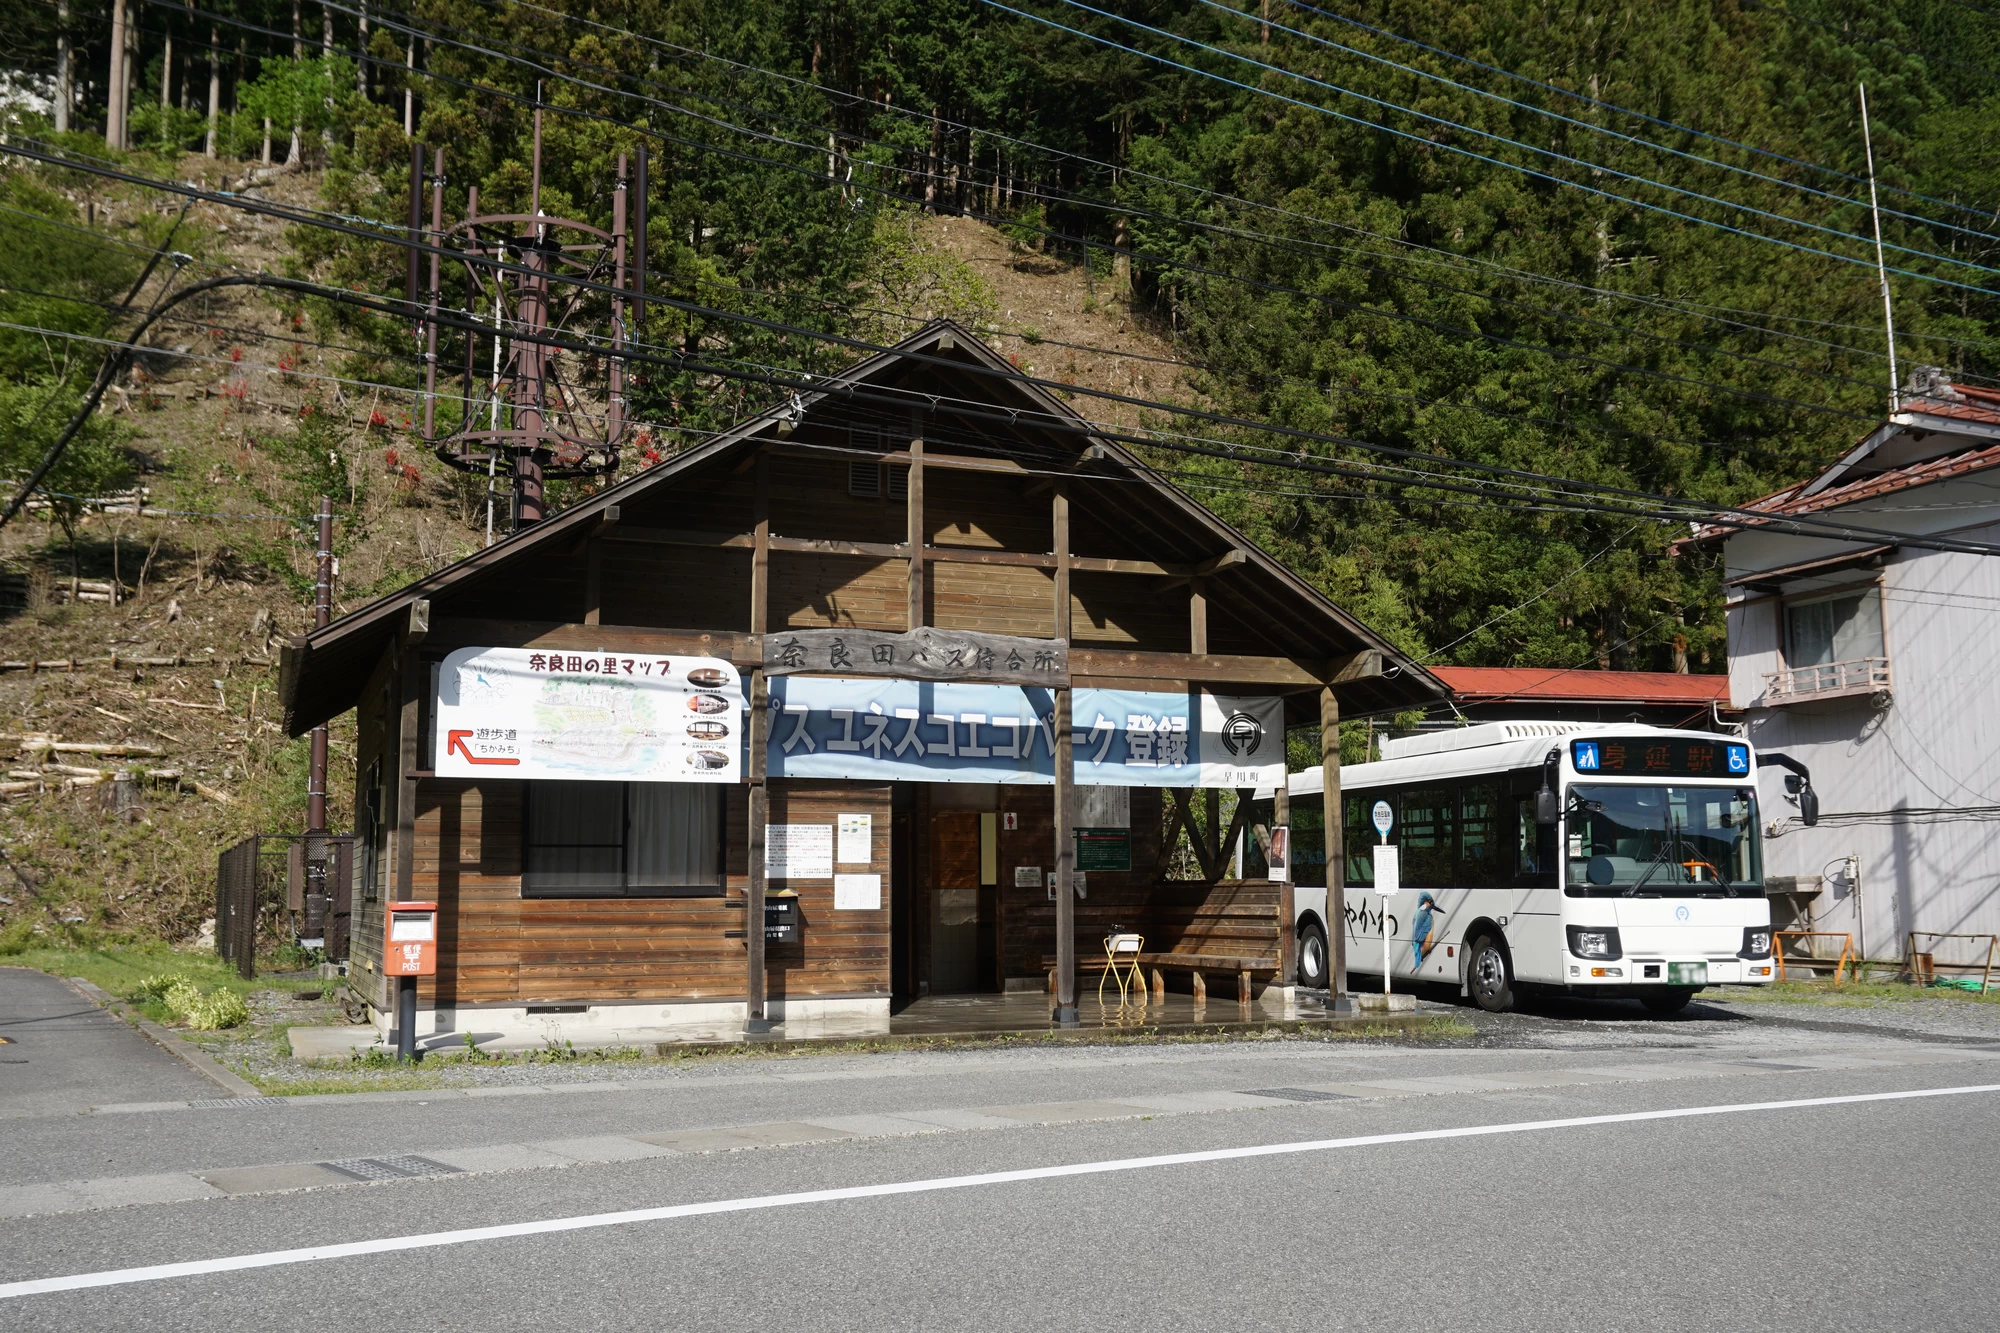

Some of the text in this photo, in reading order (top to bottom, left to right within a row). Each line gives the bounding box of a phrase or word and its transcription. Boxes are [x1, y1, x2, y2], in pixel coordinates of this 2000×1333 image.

[778, 637, 1055, 671] 奈良田バス待合所
[528, 653, 671, 676] 奈良田の里マップ
[476, 728, 517, 741] 遊歩道
[474, 743, 521, 755] 「ちかみち」
[1601, 743, 1714, 771] 身延駅
[1224, 771, 1260, 782] 早川町
[1325, 895, 1399, 946] やかわ
[403, 944, 422, 955] 郵便
[402, 962, 421, 972] POST
